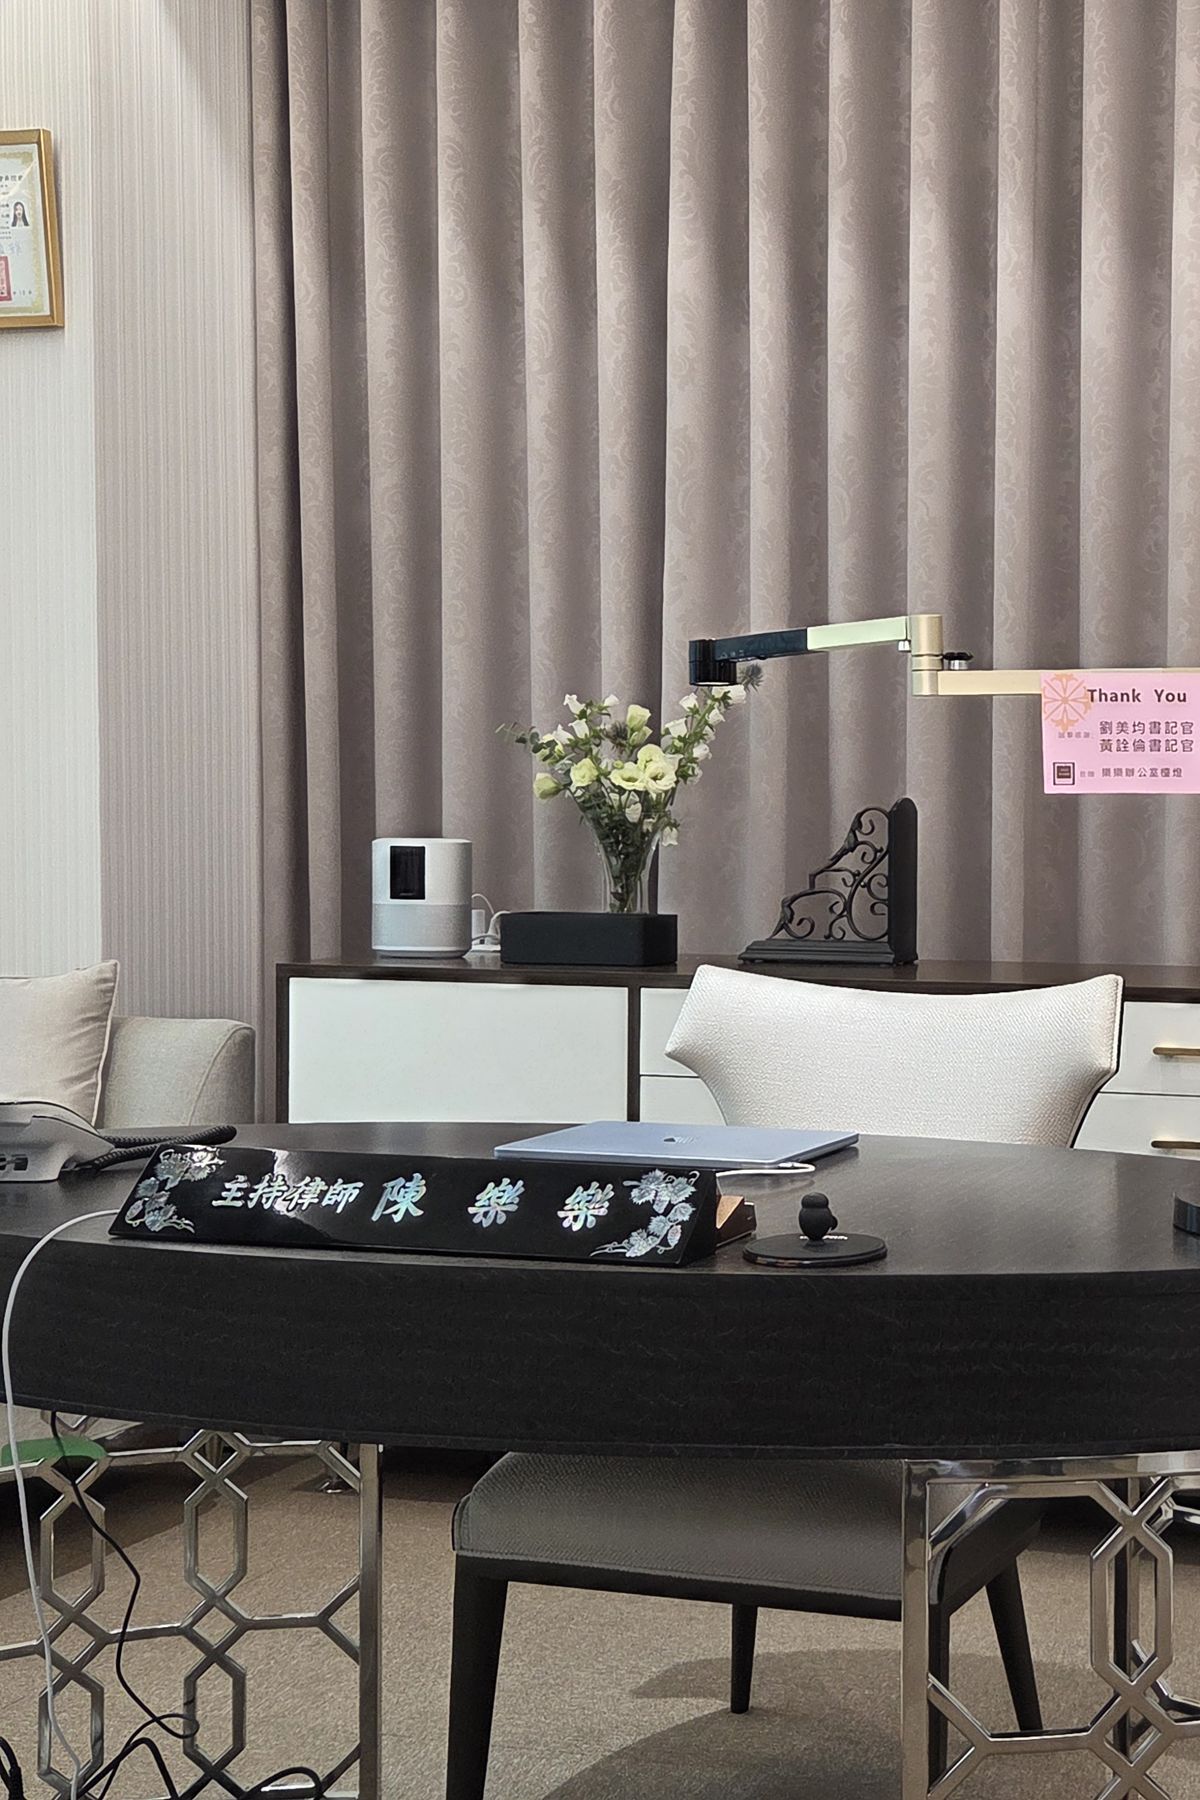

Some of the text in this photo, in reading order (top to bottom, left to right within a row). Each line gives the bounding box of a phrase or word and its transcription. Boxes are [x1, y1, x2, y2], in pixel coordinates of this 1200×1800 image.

[1087, 689, 1187, 703] Thank You
[1099, 721, 1194, 735] 劉美均書記官
[212, 1174, 364, 1213] 主持律師
